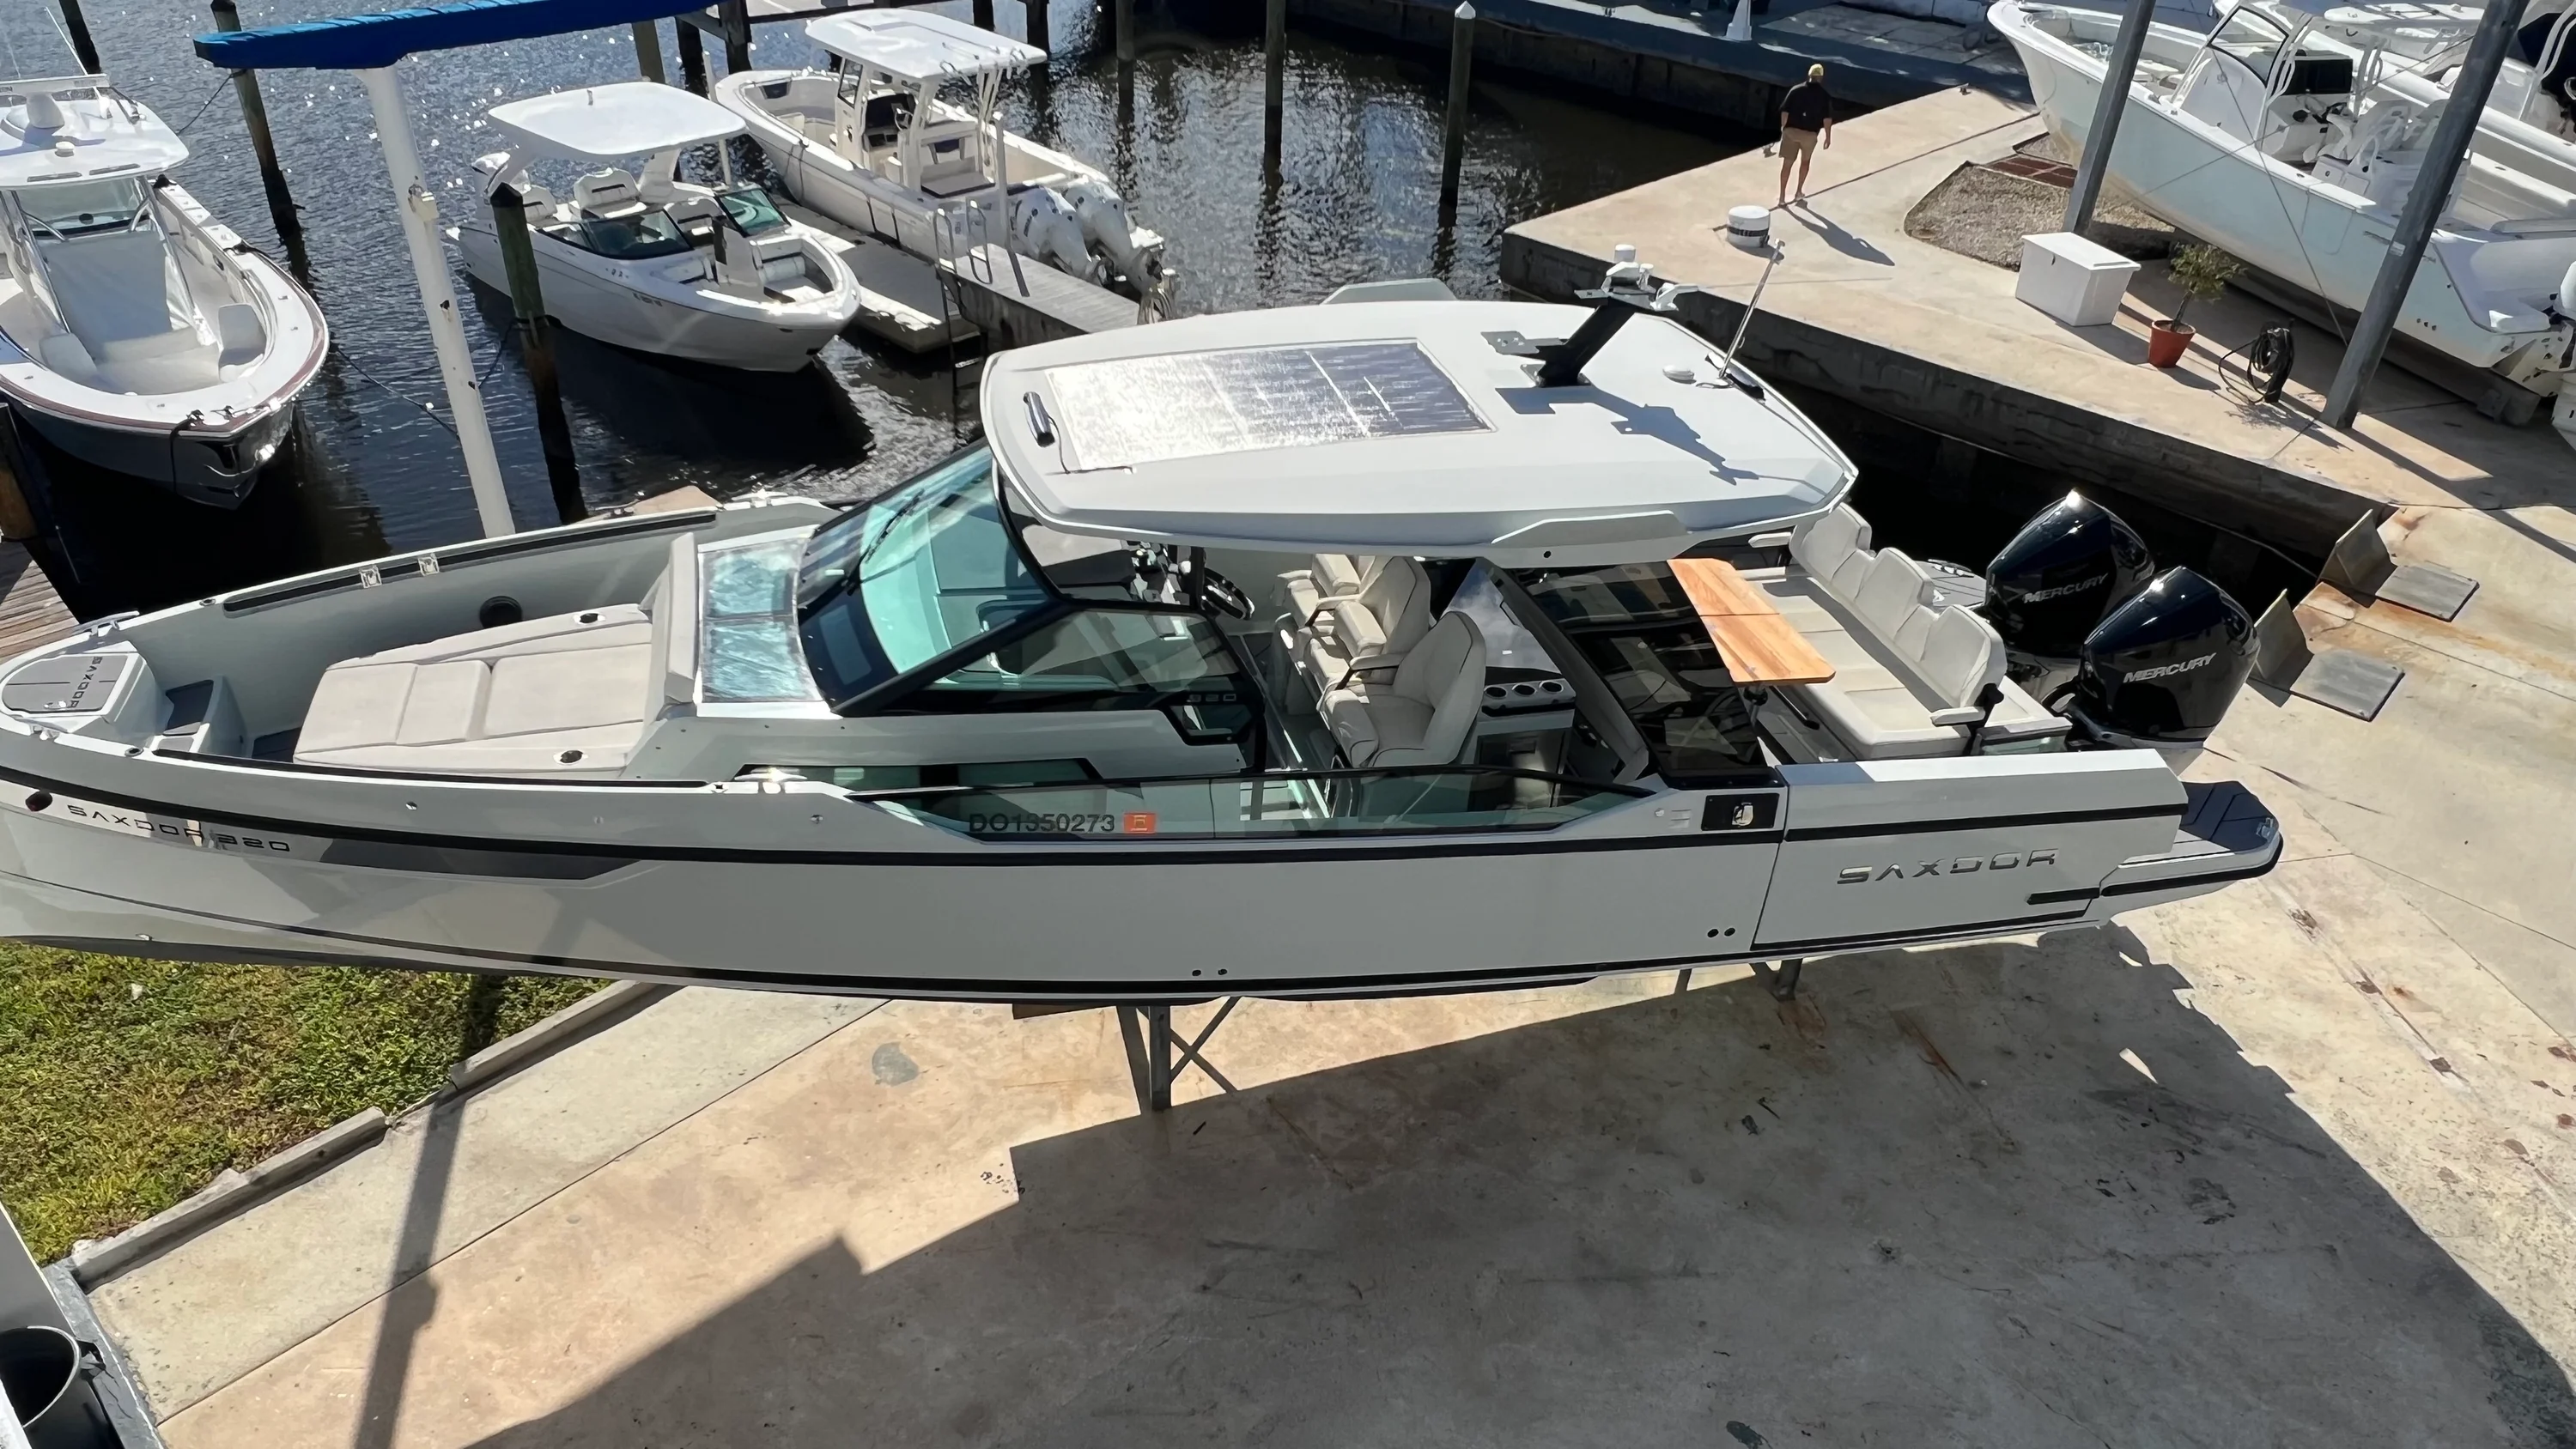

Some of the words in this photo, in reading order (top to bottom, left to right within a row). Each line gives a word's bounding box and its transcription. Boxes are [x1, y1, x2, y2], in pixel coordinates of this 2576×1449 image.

[2022, 572, 2109, 603] MERCURY
[67, 656, 103, 709] SAXDOR
[2123, 652, 2217, 683] MERCURY
[67, 804, 204, 841] SAXDOR
[217, 833, 290, 852] 320
[1836, 848, 2059, 884] SAXDOR
